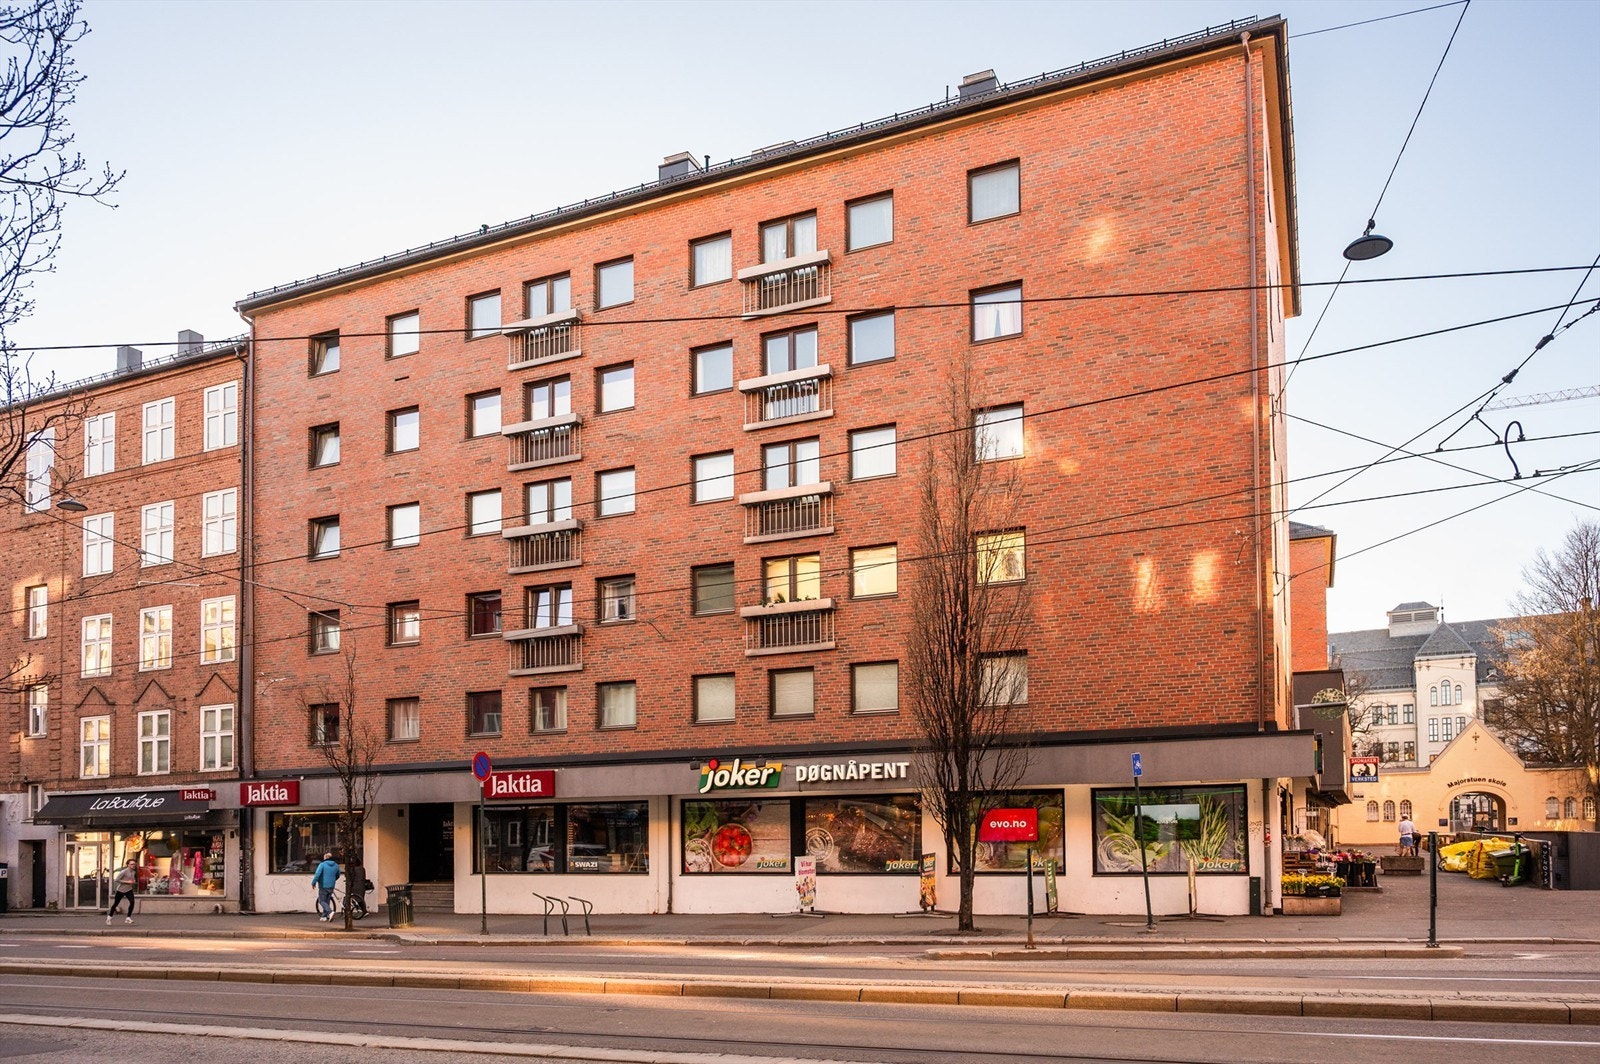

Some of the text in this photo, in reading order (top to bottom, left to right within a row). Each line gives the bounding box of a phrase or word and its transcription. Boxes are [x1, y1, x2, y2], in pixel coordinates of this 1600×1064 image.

[699, 758, 909, 794] joker DØGNÅPENT
[1447, 777, 1507, 788] Majorstuen skole
[491, 774, 542, 796] Jaktia
[184, 790, 209, 800] Jaktia
[247, 784, 288, 803] Jaktia
[990, 820, 1027, 828] evo.no
[757, 857, 785, 869] joker
[886, 858, 915, 871] joker
[1199, 856, 1236, 870] joker
